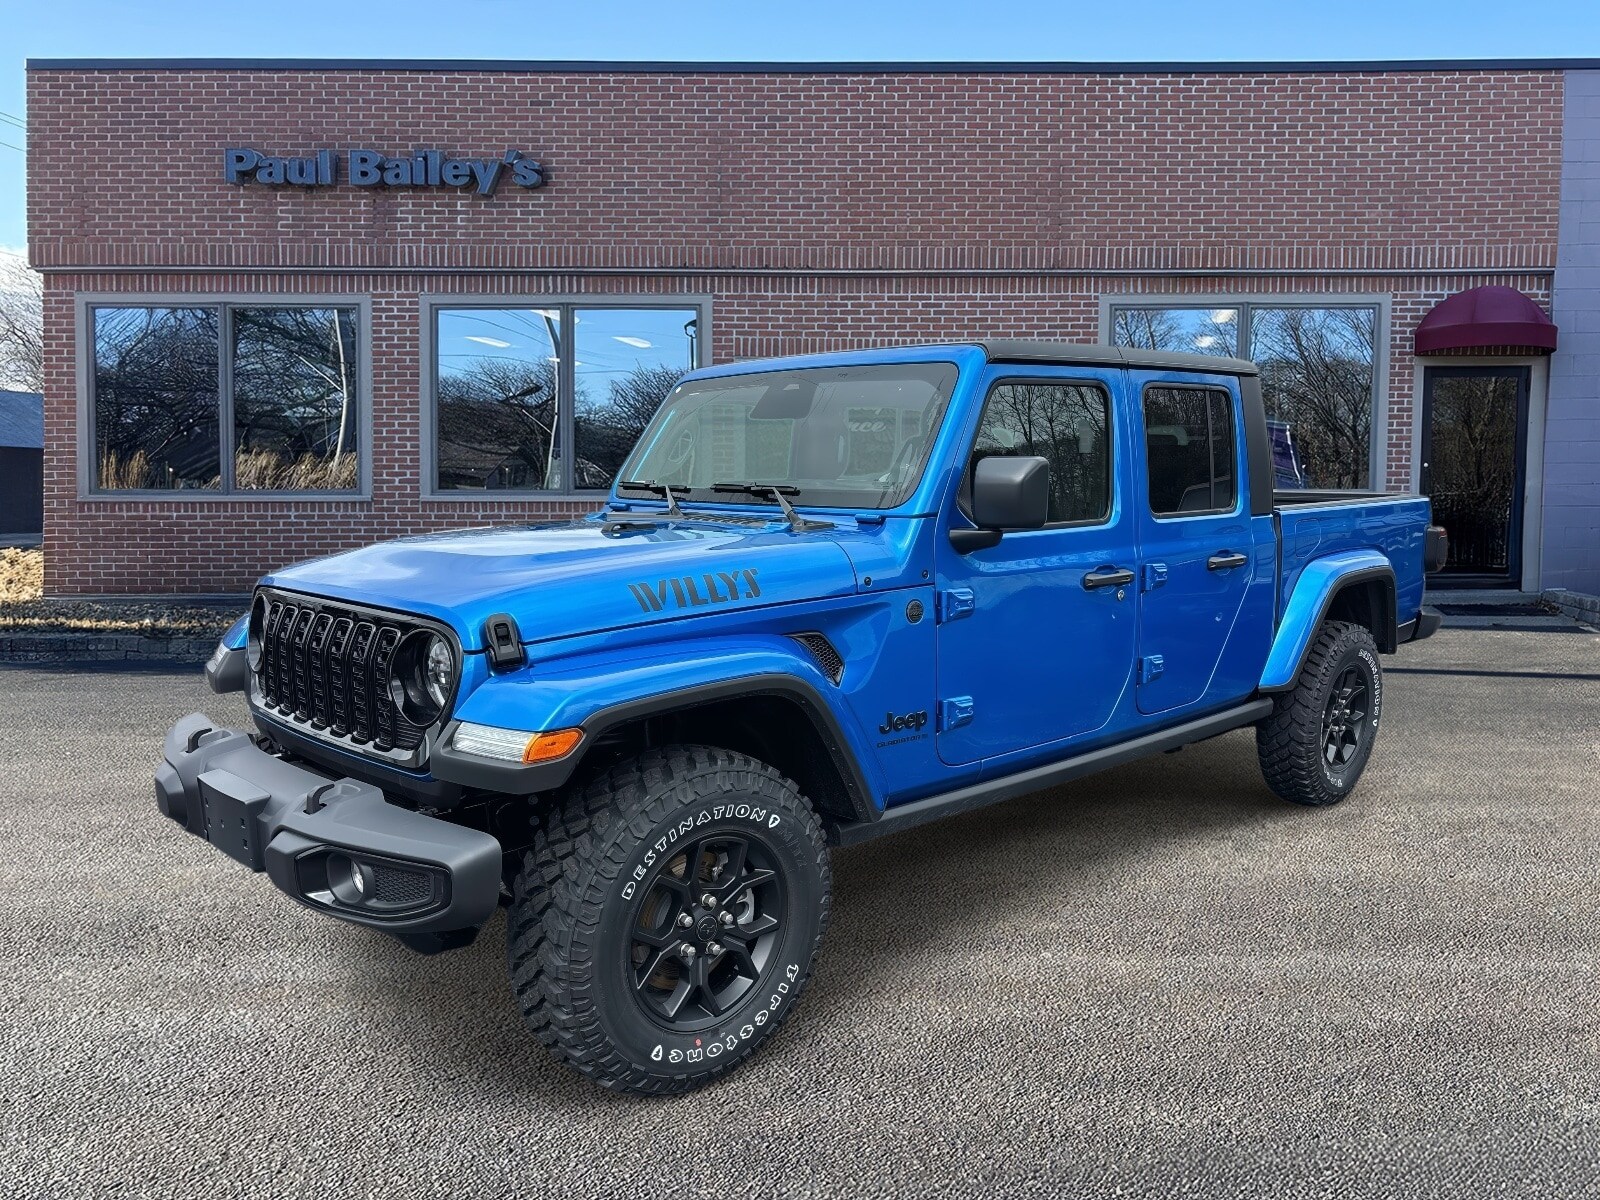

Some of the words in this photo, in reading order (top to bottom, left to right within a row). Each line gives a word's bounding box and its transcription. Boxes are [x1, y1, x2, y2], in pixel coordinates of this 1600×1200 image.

[225, 148, 335, 187] Paul
[350, 149, 542, 196] Bailey's
[627, 568, 761, 613] WILLYS
[879, 710, 928, 735] Jeep
[621, 804, 767, 900] DESTINATION
